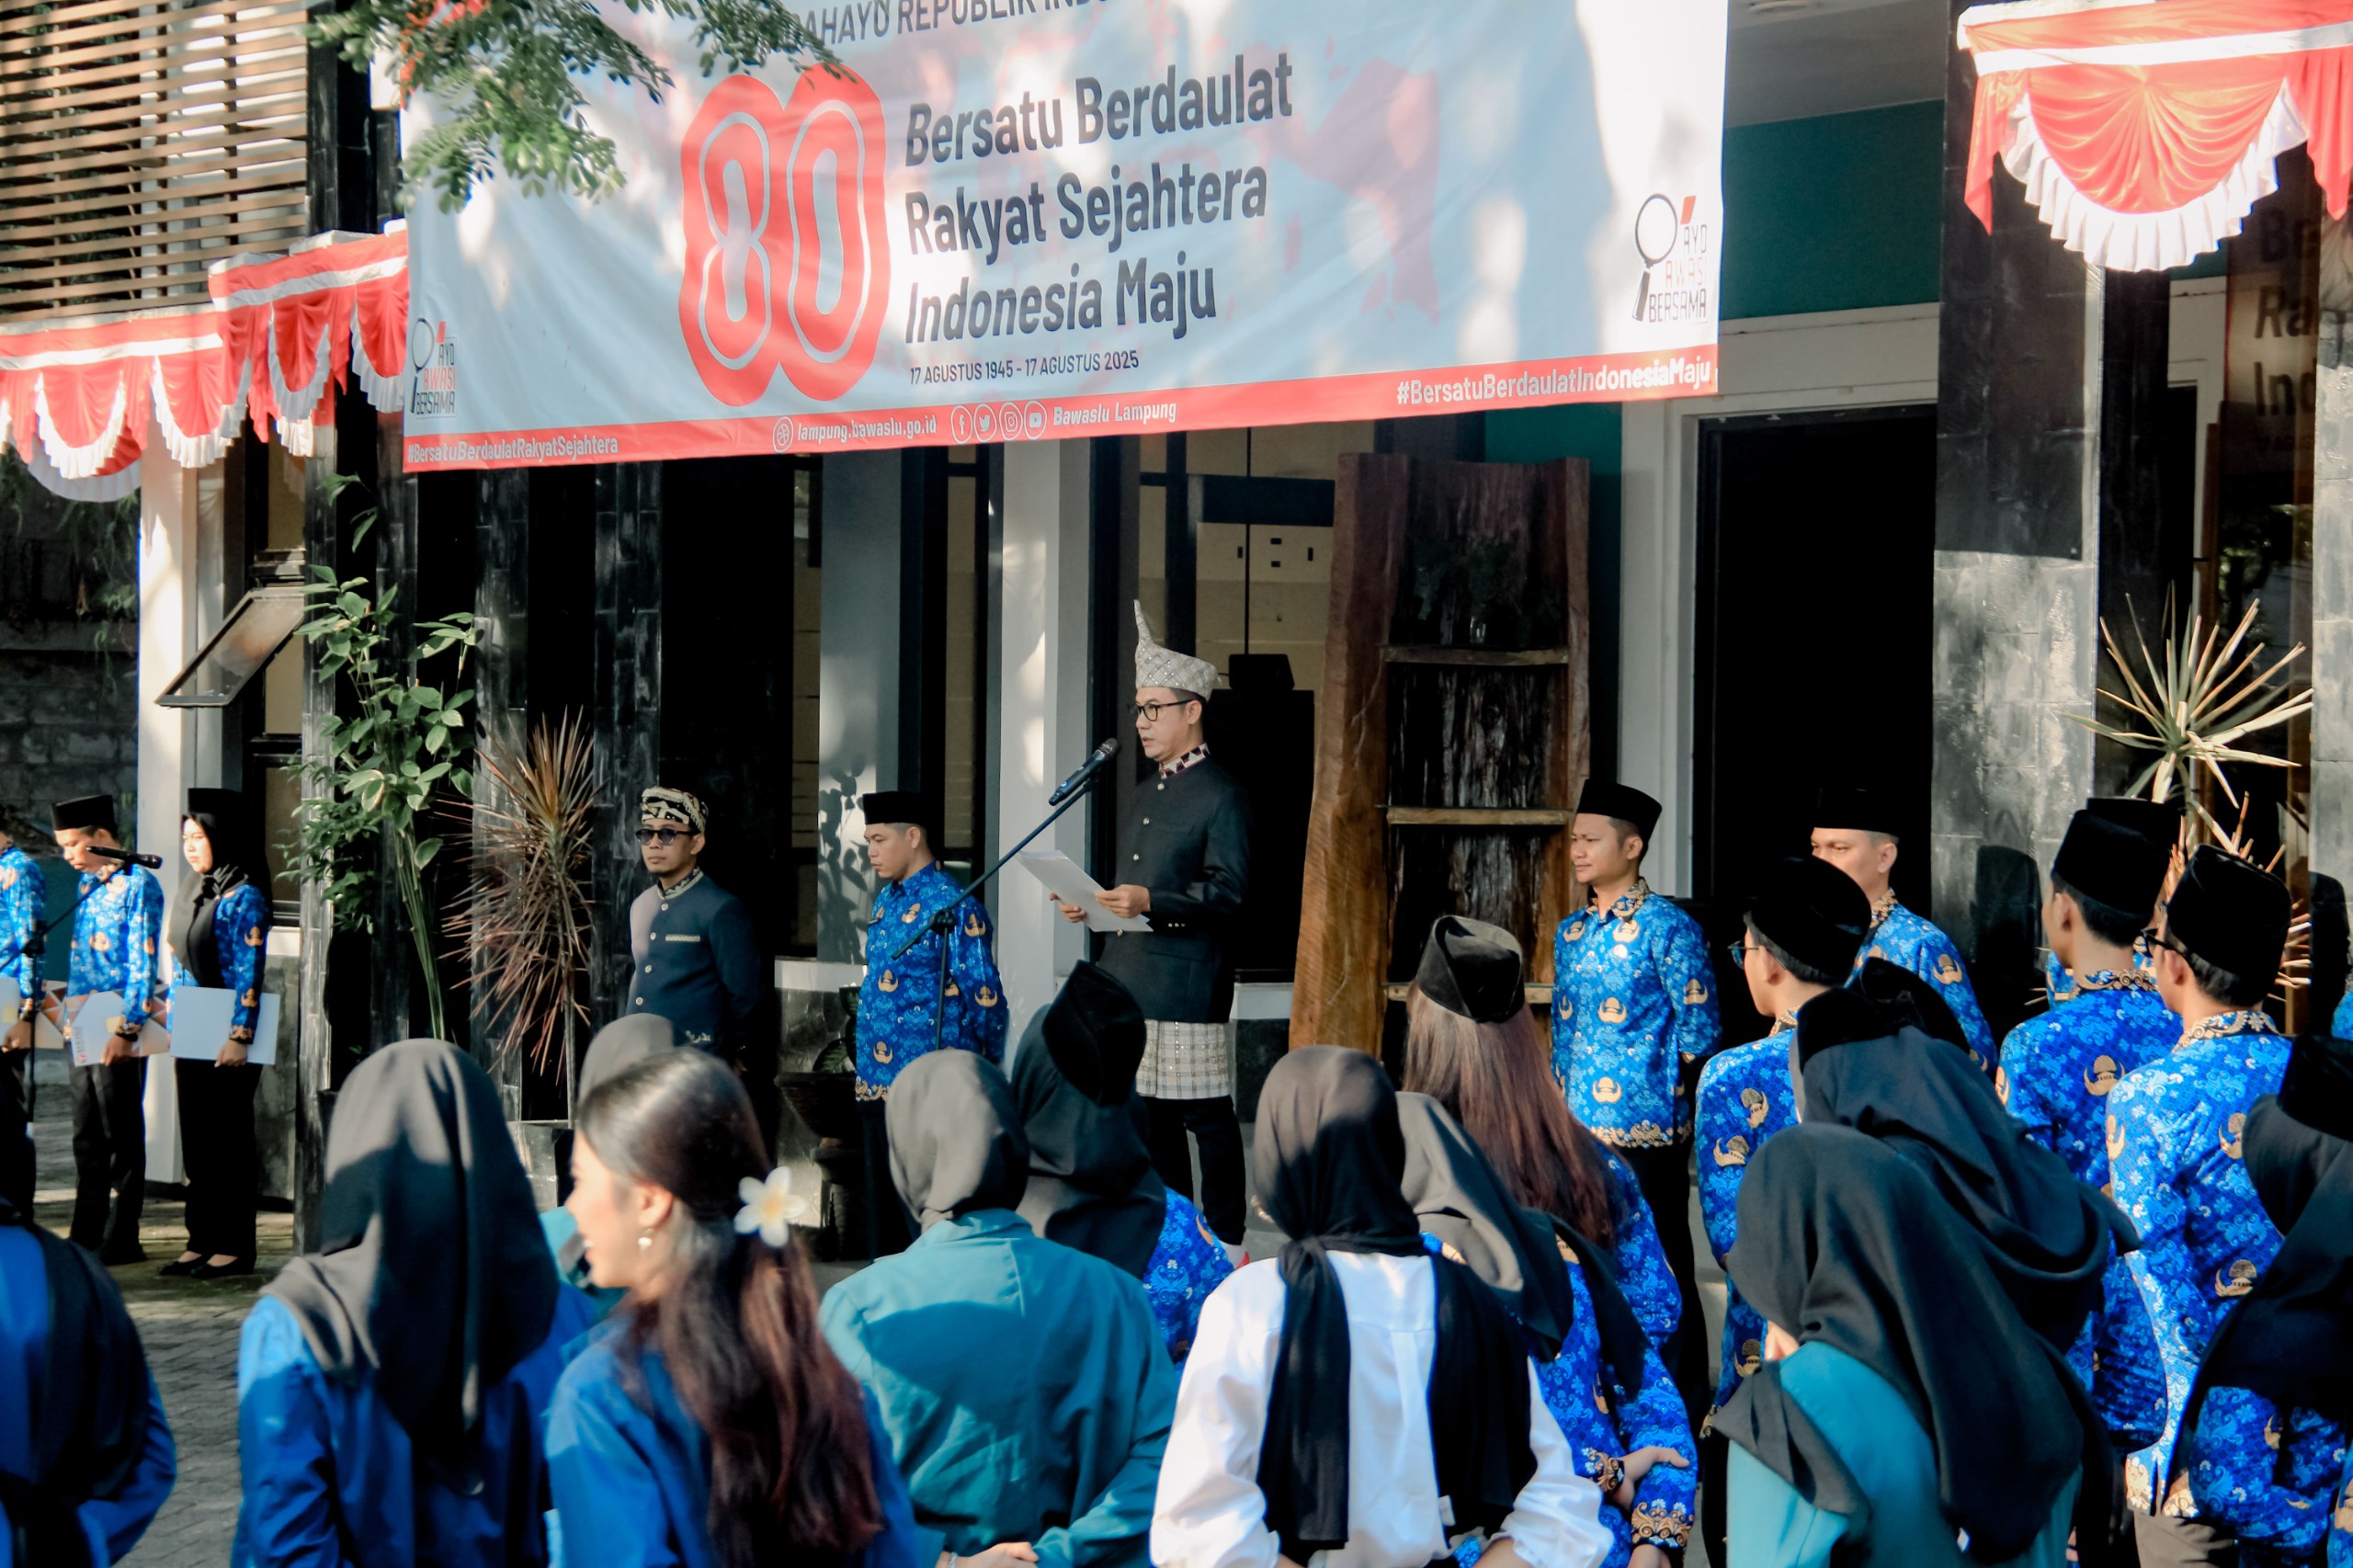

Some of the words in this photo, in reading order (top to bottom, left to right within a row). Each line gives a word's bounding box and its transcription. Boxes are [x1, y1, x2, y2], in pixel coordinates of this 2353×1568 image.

[905, 91, 1063, 167] Bersatu
[1074, 52, 1293, 144] Berdaulat
[905, 181, 1047, 266] Rakyat
[1057, 161, 1267, 254] Sejahtera
[679, 63, 891, 407] 80
[1684, 223, 1708, 256] AYO
[1665, 256, 1707, 289] AWASI
[905, 262, 1103, 344] Indonesia
[1116, 250, 1216, 340] Maju
[1649, 288, 1707, 323] BERSAMA
[438, 343, 455, 366] AYO
[910, 367, 921, 385] 17
[924, 363, 983, 384] AGUSTUS
[984, 359, 1014, 380] 1945
[1025, 358, 1037, 377] 17
[1040, 353, 1100, 375] AGUSTUS
[1104, 350, 1140, 371] 2025
[424, 367, 456, 390] AWASI
[1397, 356, 1711, 405] #BersatuBerdaulatIndonesiaMaju
[415, 391, 456, 415] BERSAMA
[1053, 403, 1109, 426] Bawaslu
[1115, 402, 1177, 425] Lampung
[797, 415, 937, 444] lampung.bawaslu.go.id
[408, 435, 619, 462] #BersatuBerdaulatRakyatSejahtera
